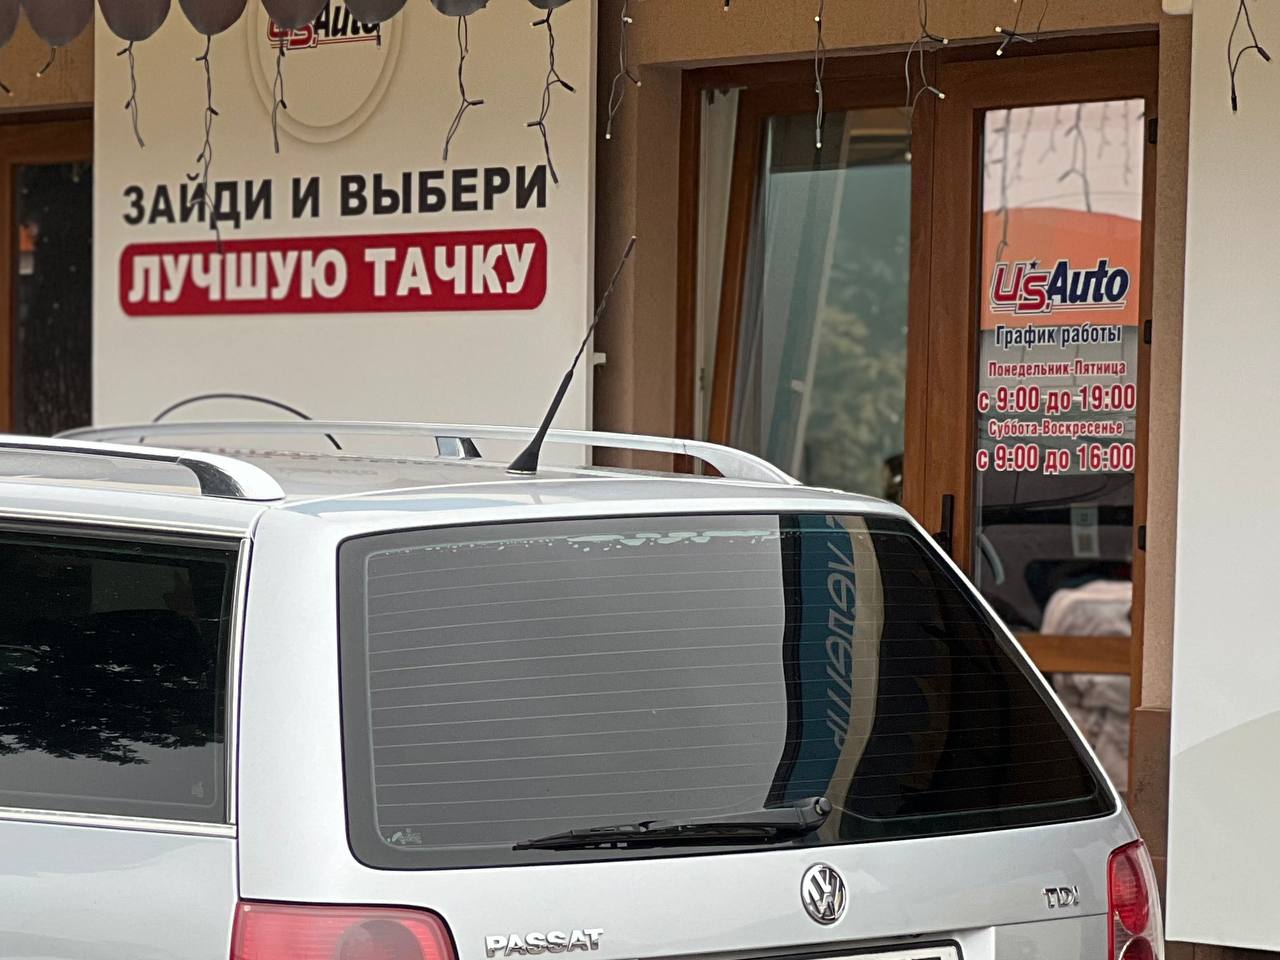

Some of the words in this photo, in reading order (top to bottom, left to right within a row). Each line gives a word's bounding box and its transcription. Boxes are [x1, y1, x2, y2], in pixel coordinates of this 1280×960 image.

[123, 173, 272, 230] ЗАЙДИ
[292, 176, 320, 218] И
[340, 164, 547, 216] ВЫБЕРИ
[128, 248, 347, 303] ЛУЧШУЮ
[365, 243, 536, 297] ТАЧКУ
[996, 325, 1056, 349] График
[1062, 323, 1121, 348] работы
[997, 386, 1040, 411] 9:00
[1046, 391, 1071, 413] до
[1079, 384, 1135, 410] 19:00
[995, 445, 1038, 470] 9:00
[1044, 450, 1069, 473] до
[1078, 444, 1135, 470] 16:00
[1041, 886, 1080, 909] TDI
[485, 928, 604, 958] PASSAT
